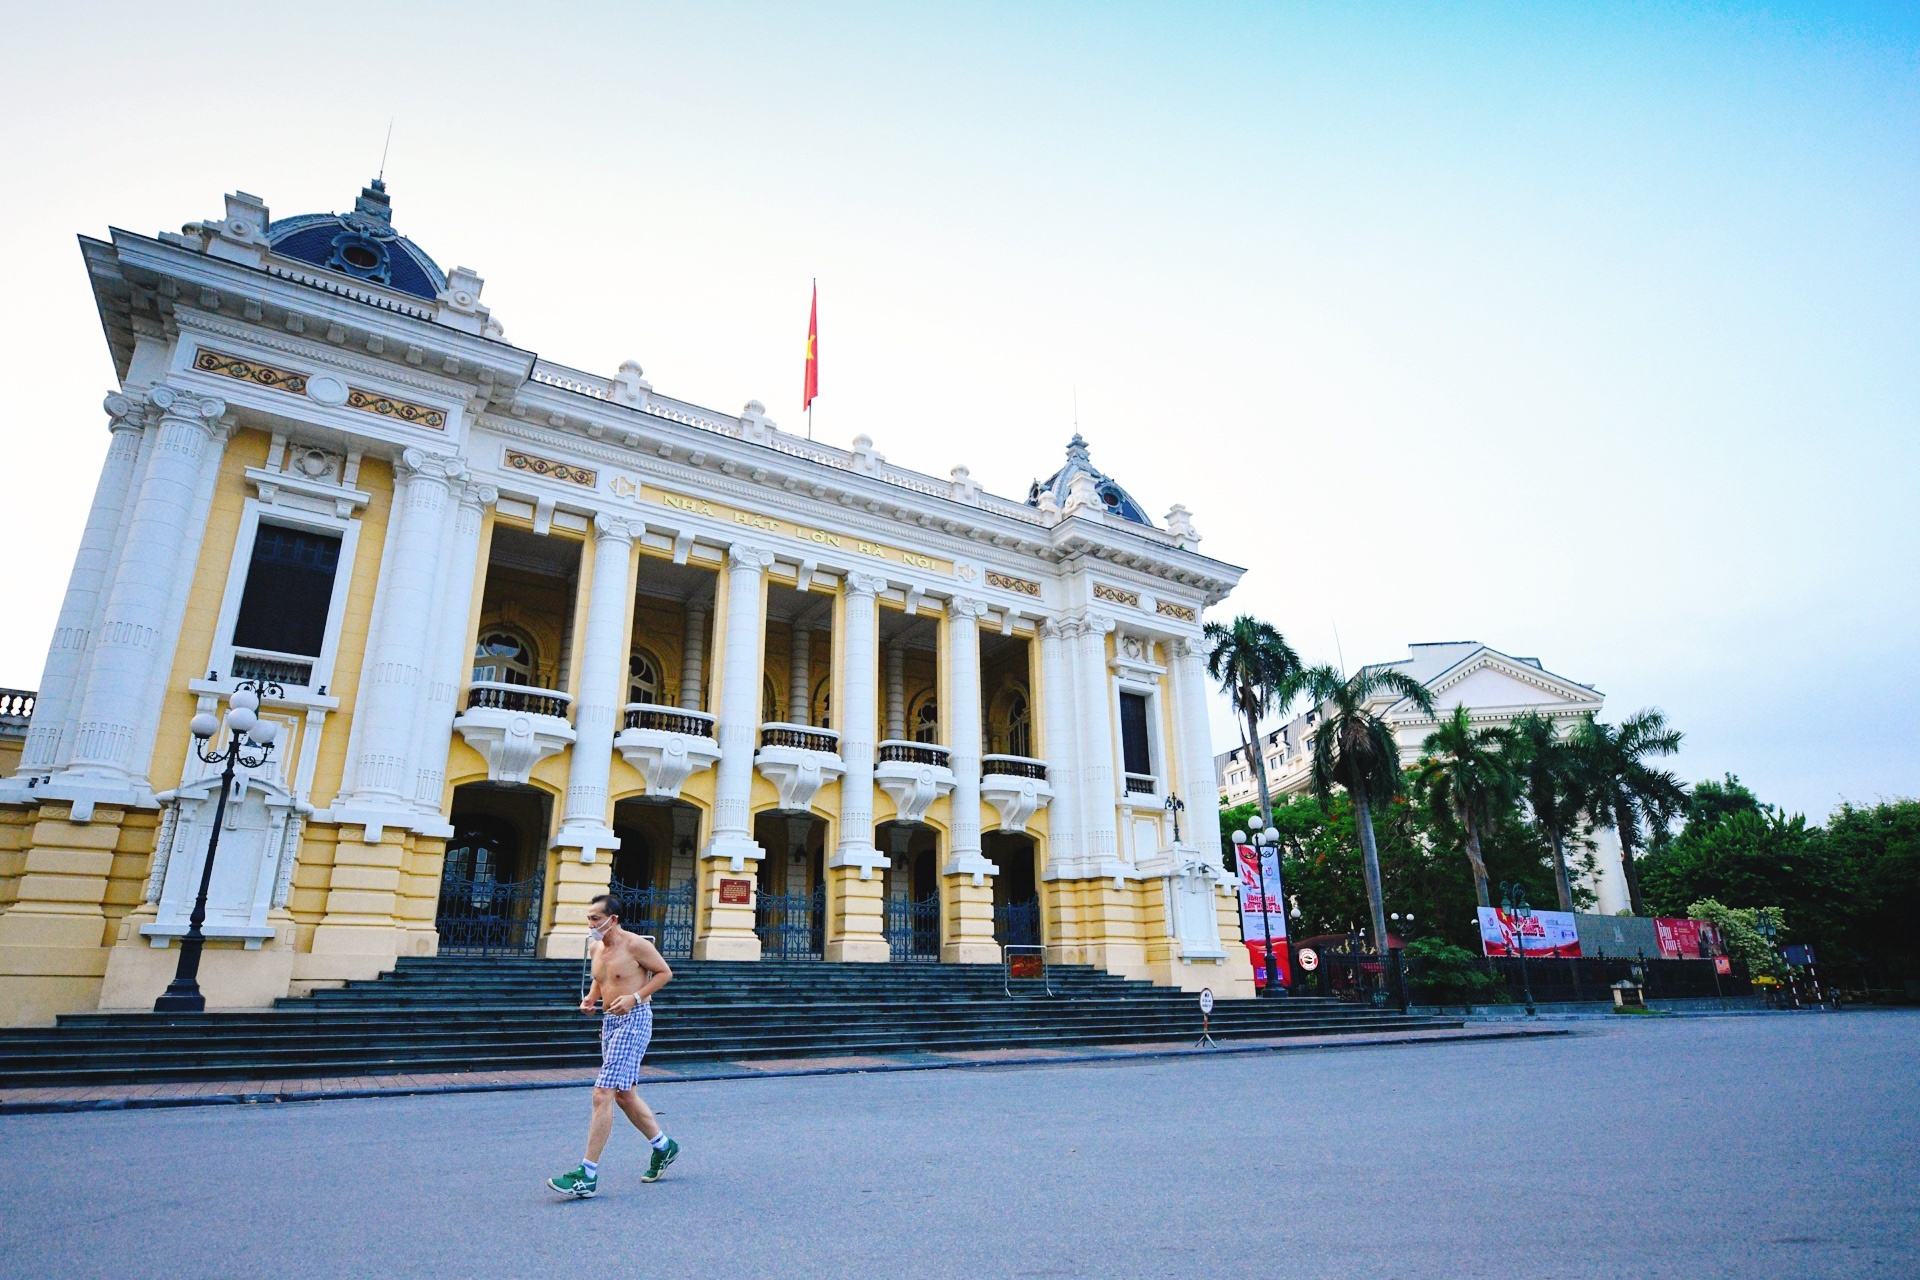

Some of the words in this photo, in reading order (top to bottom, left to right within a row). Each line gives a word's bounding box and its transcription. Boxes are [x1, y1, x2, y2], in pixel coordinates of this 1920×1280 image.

[664, 494, 716, 517] NHÀ
[734, 512, 779, 531] HÁT
[858, 542, 886, 558] HÀ
